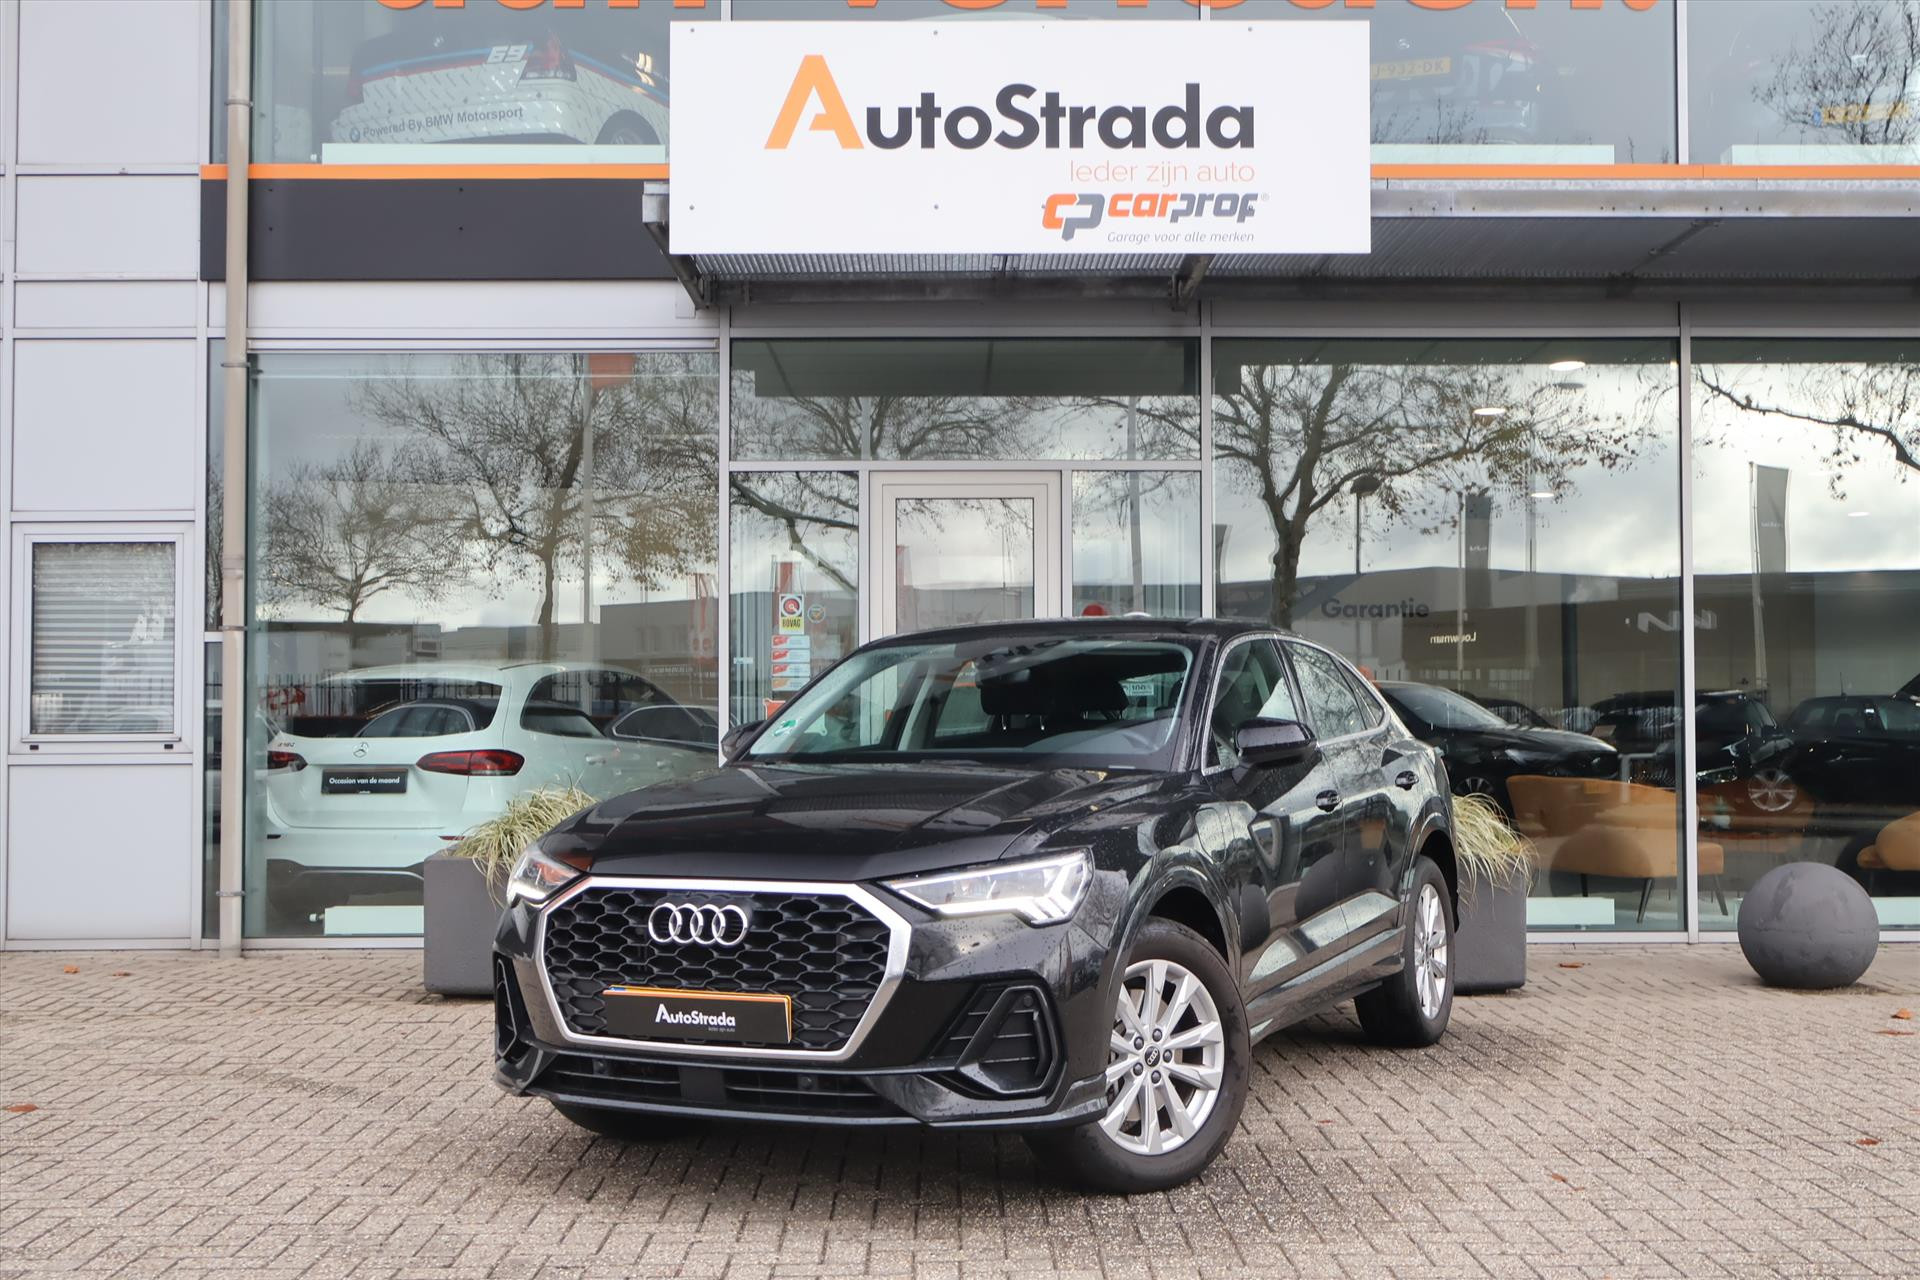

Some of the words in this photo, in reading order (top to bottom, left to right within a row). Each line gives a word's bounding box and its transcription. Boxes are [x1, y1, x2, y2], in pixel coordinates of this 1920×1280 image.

[487, 44, 528, 63] 69
[764, 54, 1255, 149] AutoStrada
[363, 120, 405, 138] Powered
[408, 119, 422, 132] By
[425, 113, 454, 128] BMW
[457, 106, 524, 123] Motorsport
[1070, 160, 1138, 182] Ieder
[1146, 161, 1188, 187] zijn
[1196, 162, 1255, 182] auto
[1107, 193, 1258, 223] carprof
[1107, 231, 1150, 245] Garage
[1154, 233, 1181, 243] voor
[1184, 231, 1207, 242] alle
[1209, 231, 1255, 242] merken
[1321, 597, 1429, 618] Garantie
[378, 776, 401, 784] maand
[655, 1003, 736, 1027] AutoStrada
